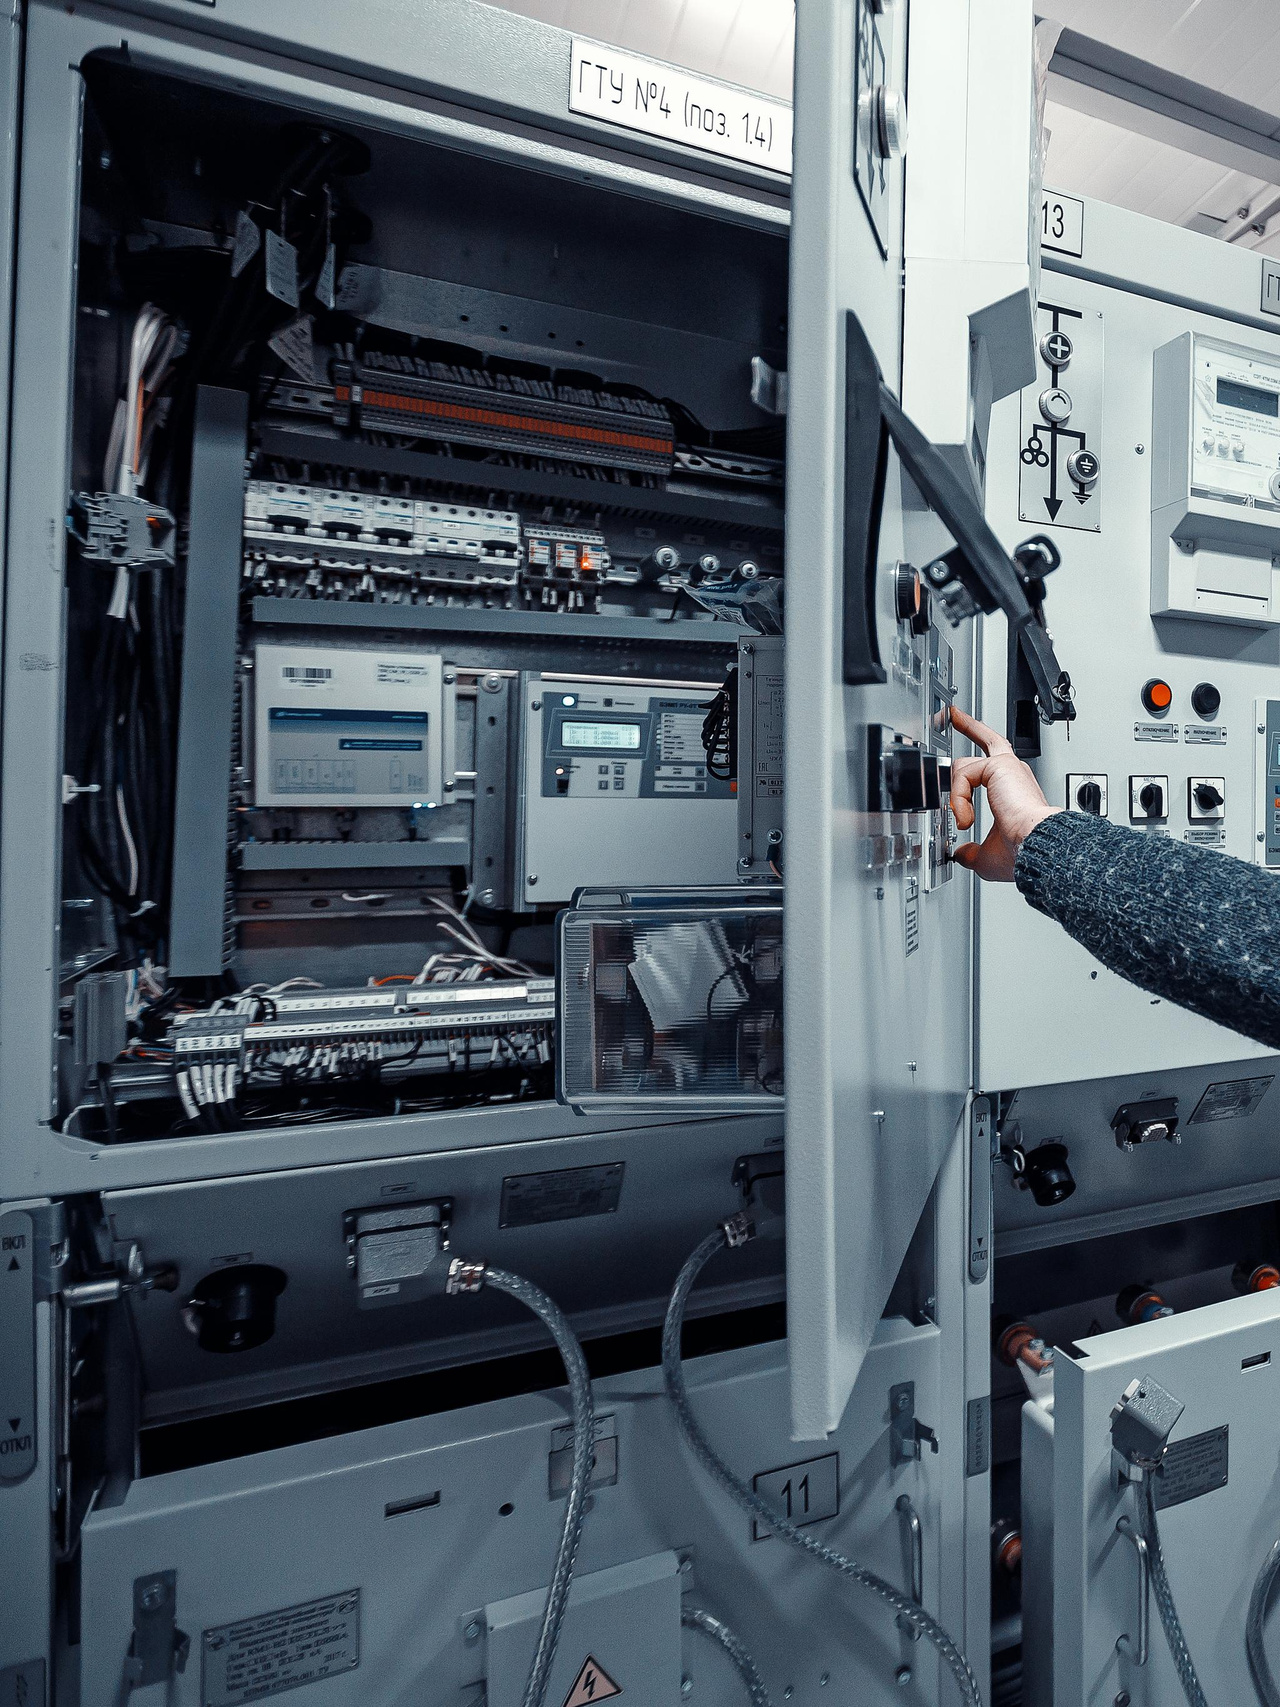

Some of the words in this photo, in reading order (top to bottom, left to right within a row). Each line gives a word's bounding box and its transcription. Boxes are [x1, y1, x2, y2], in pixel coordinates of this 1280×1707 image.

[579, 59, 624, 104] ГТУ
[635, 78, 671, 119] №4
[684, 91, 730, 138] (поз.
[741, 112, 773, 152] 1.4)
[1041, 200, 1065, 239] 13
[976, 1112, 987, 1123] ВКЛ
[2, 1234, 26, 1249] ВКЛ
[972, 1250, 988, 1261] ОТКЛ
[0, 1435, 32, 1450] ОТКЛ
[781, 1472, 809, 1519] 11
